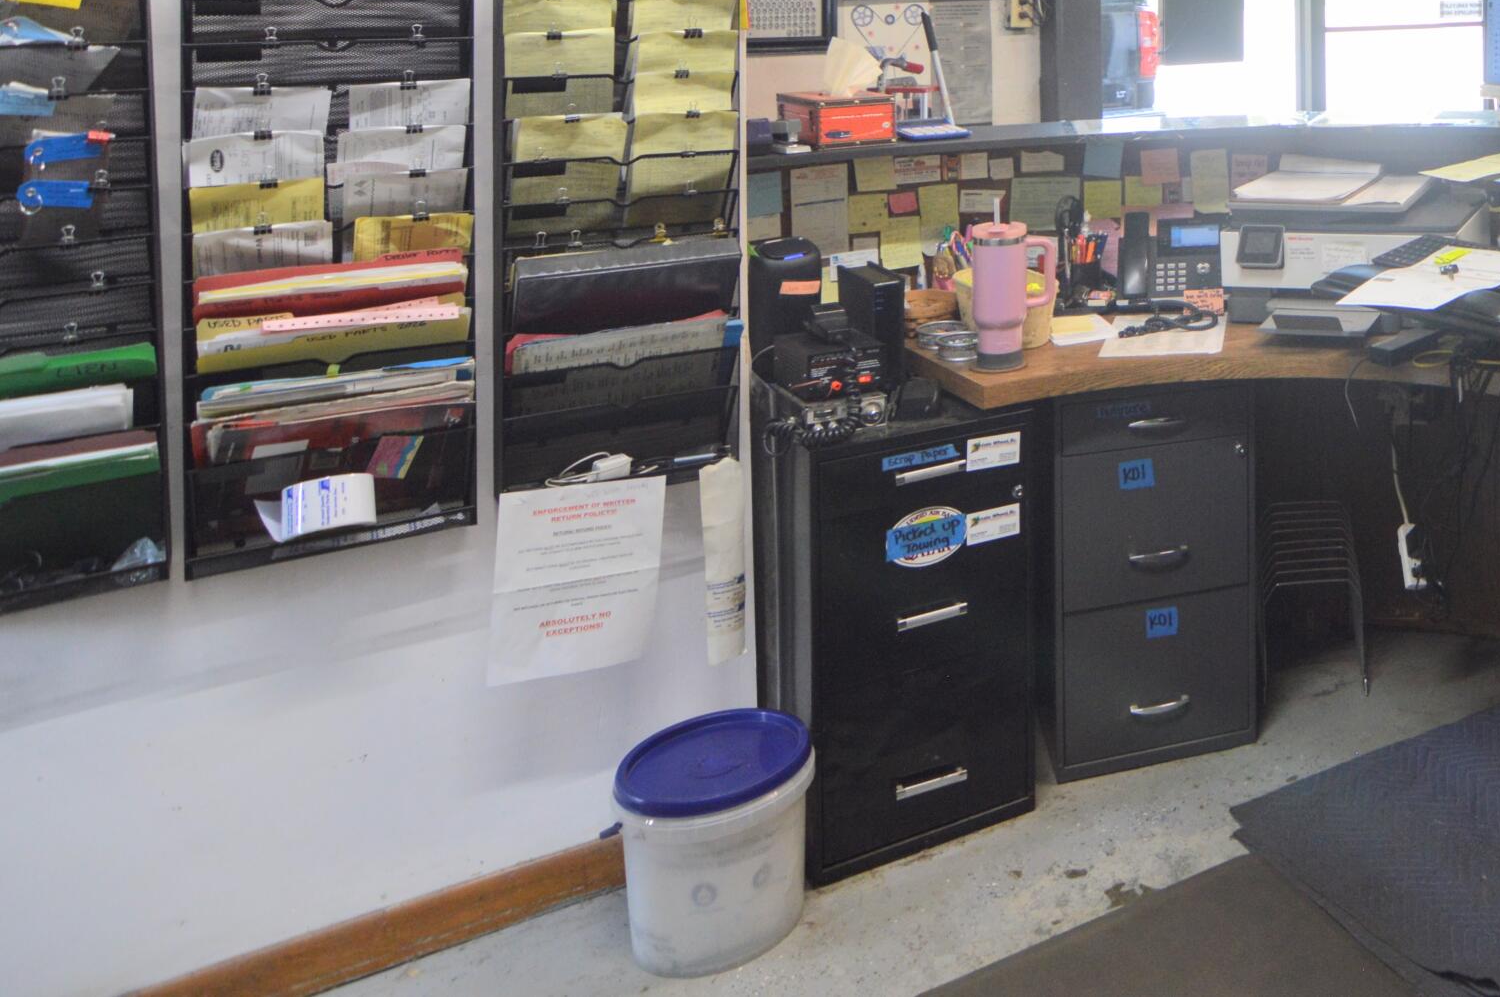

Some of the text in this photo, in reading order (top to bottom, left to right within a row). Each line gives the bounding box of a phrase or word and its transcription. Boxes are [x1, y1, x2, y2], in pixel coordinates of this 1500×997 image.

[207, 318, 242, 329] USED
[306, 334, 337, 343] USED
[345, 324, 388, 339] PARTS
[532, 503, 593, 517] ENFORCEMENT
[602, 498, 637, 508] WRITTEN
[551, 513, 582, 523] RETURN
[893, 521, 938, 546] Picked
[538, 610, 612, 629] ABSOLUTELY NO
[544, 621, 605, 638] EXCEPTIONS!
